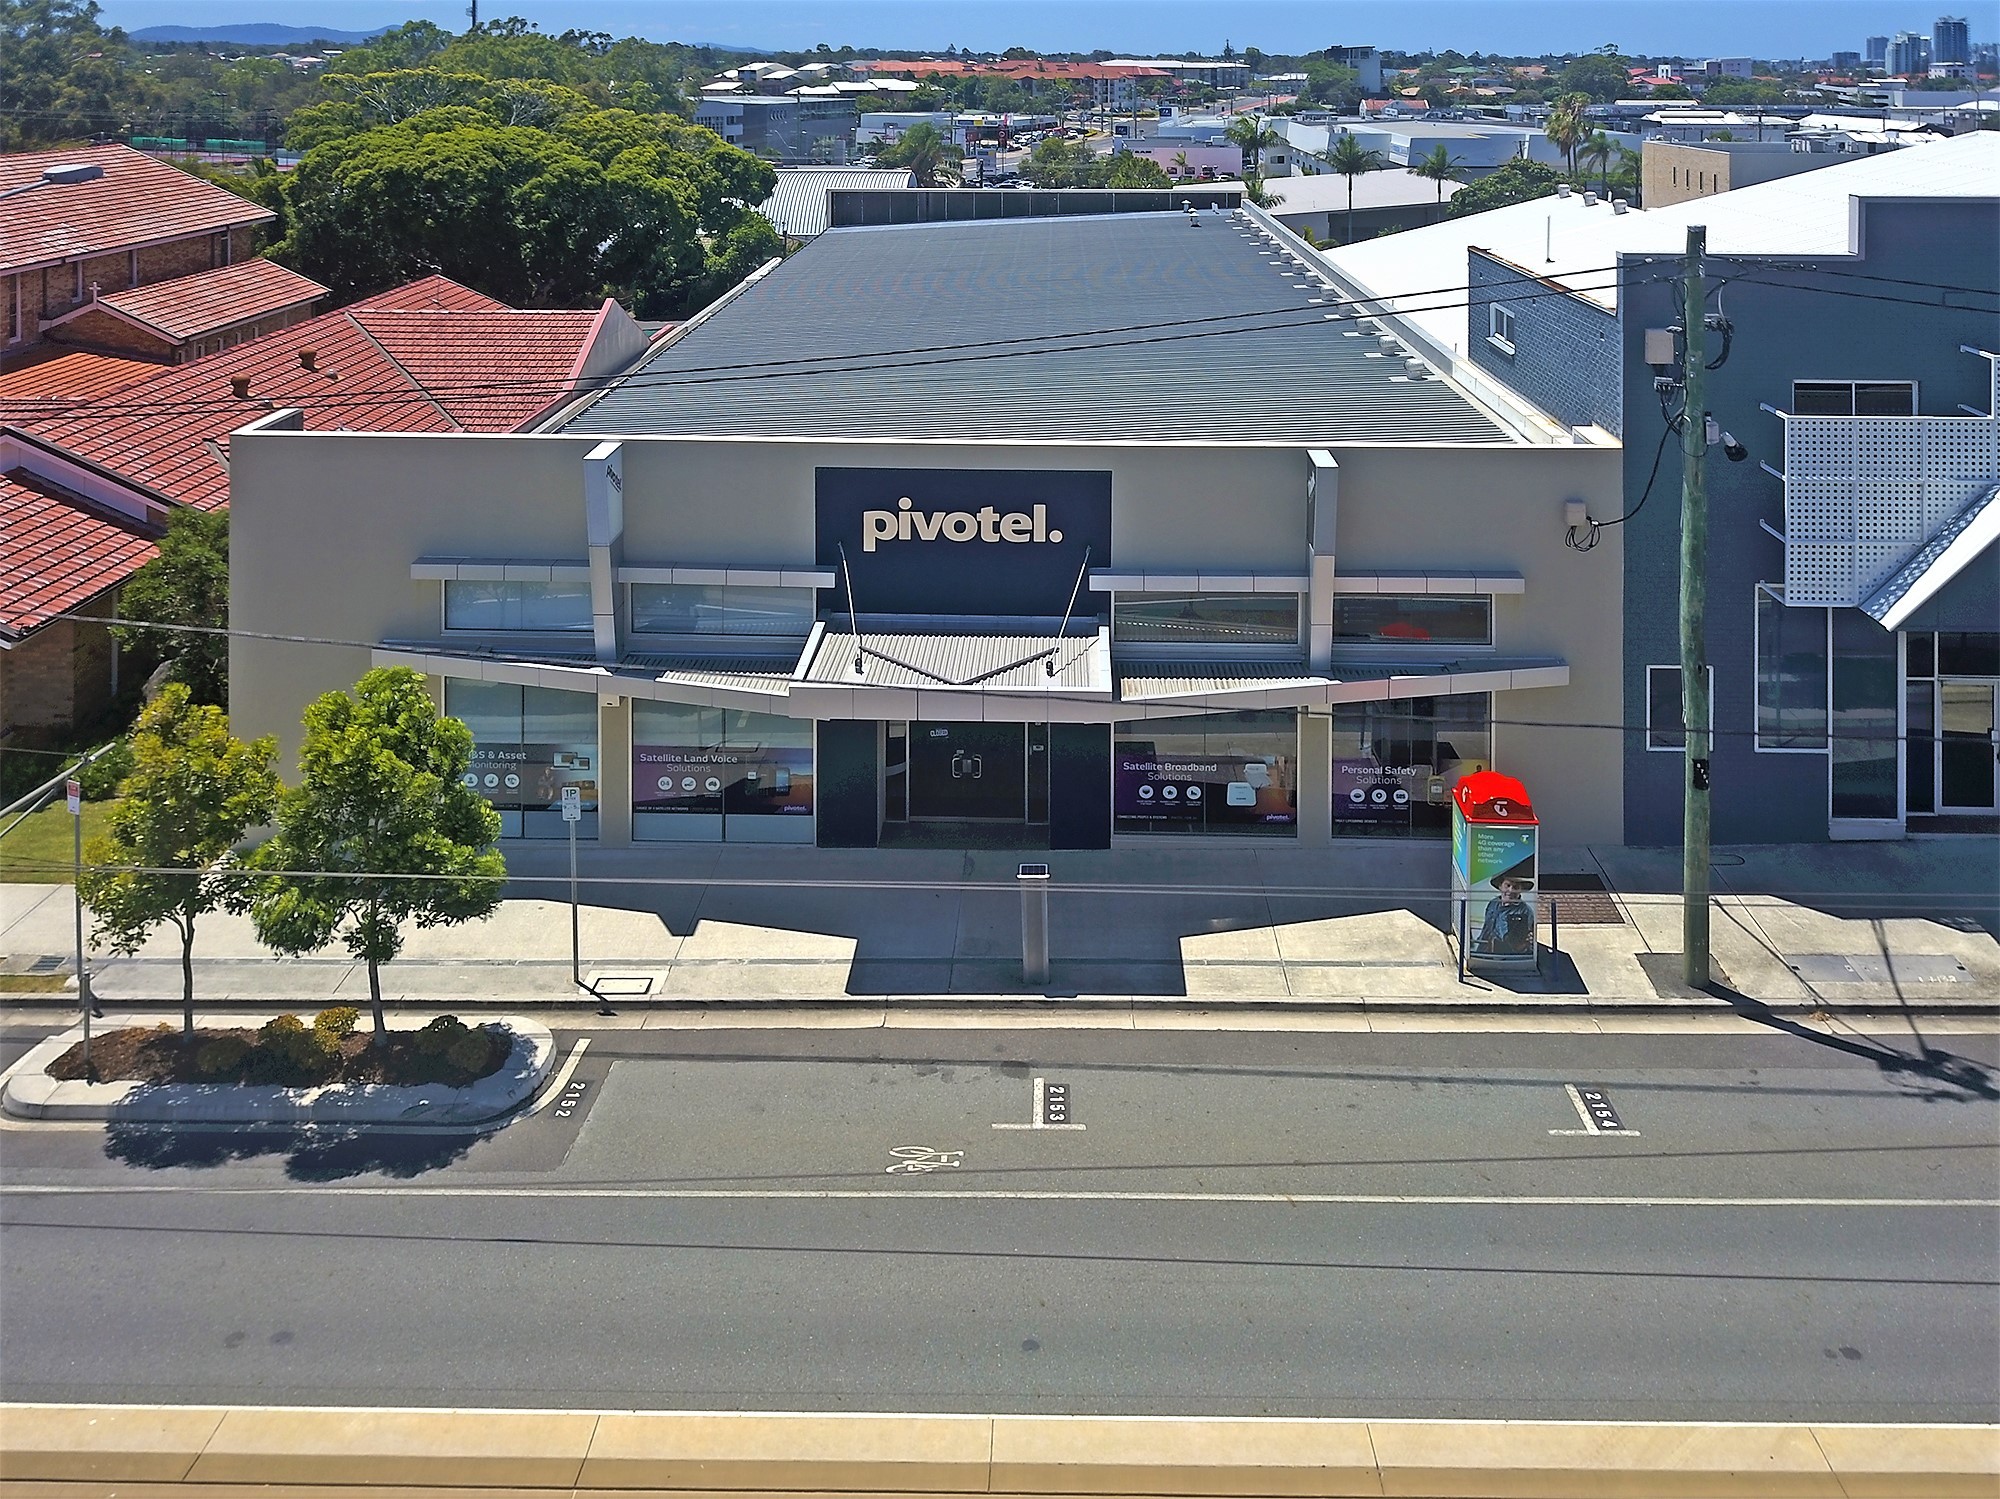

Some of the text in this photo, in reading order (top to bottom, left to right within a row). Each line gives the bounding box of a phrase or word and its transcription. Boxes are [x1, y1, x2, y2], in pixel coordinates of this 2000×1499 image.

[863, 496, 1064, 552] pivotel.
[487, 750, 496, 760] &
[497, 750, 527, 760] Asset
[640, 753, 738, 764] Satellite Land Voice
[666, 763, 712, 773] Solutions
[1122, 761, 1217, 772] Satellite Broadband
[1341, 765, 1417, 777] Personal Safety
[1147, 772, 1193, 782] Solutions
[1356, 775, 1402, 785] Solutions
[565, 789, 577, 798] 1P
[554, 1081, 588, 1118] 2152
[1049, 1086, 1067, 1122] 2153
[1584, 1091, 1619, 1128] 2154
